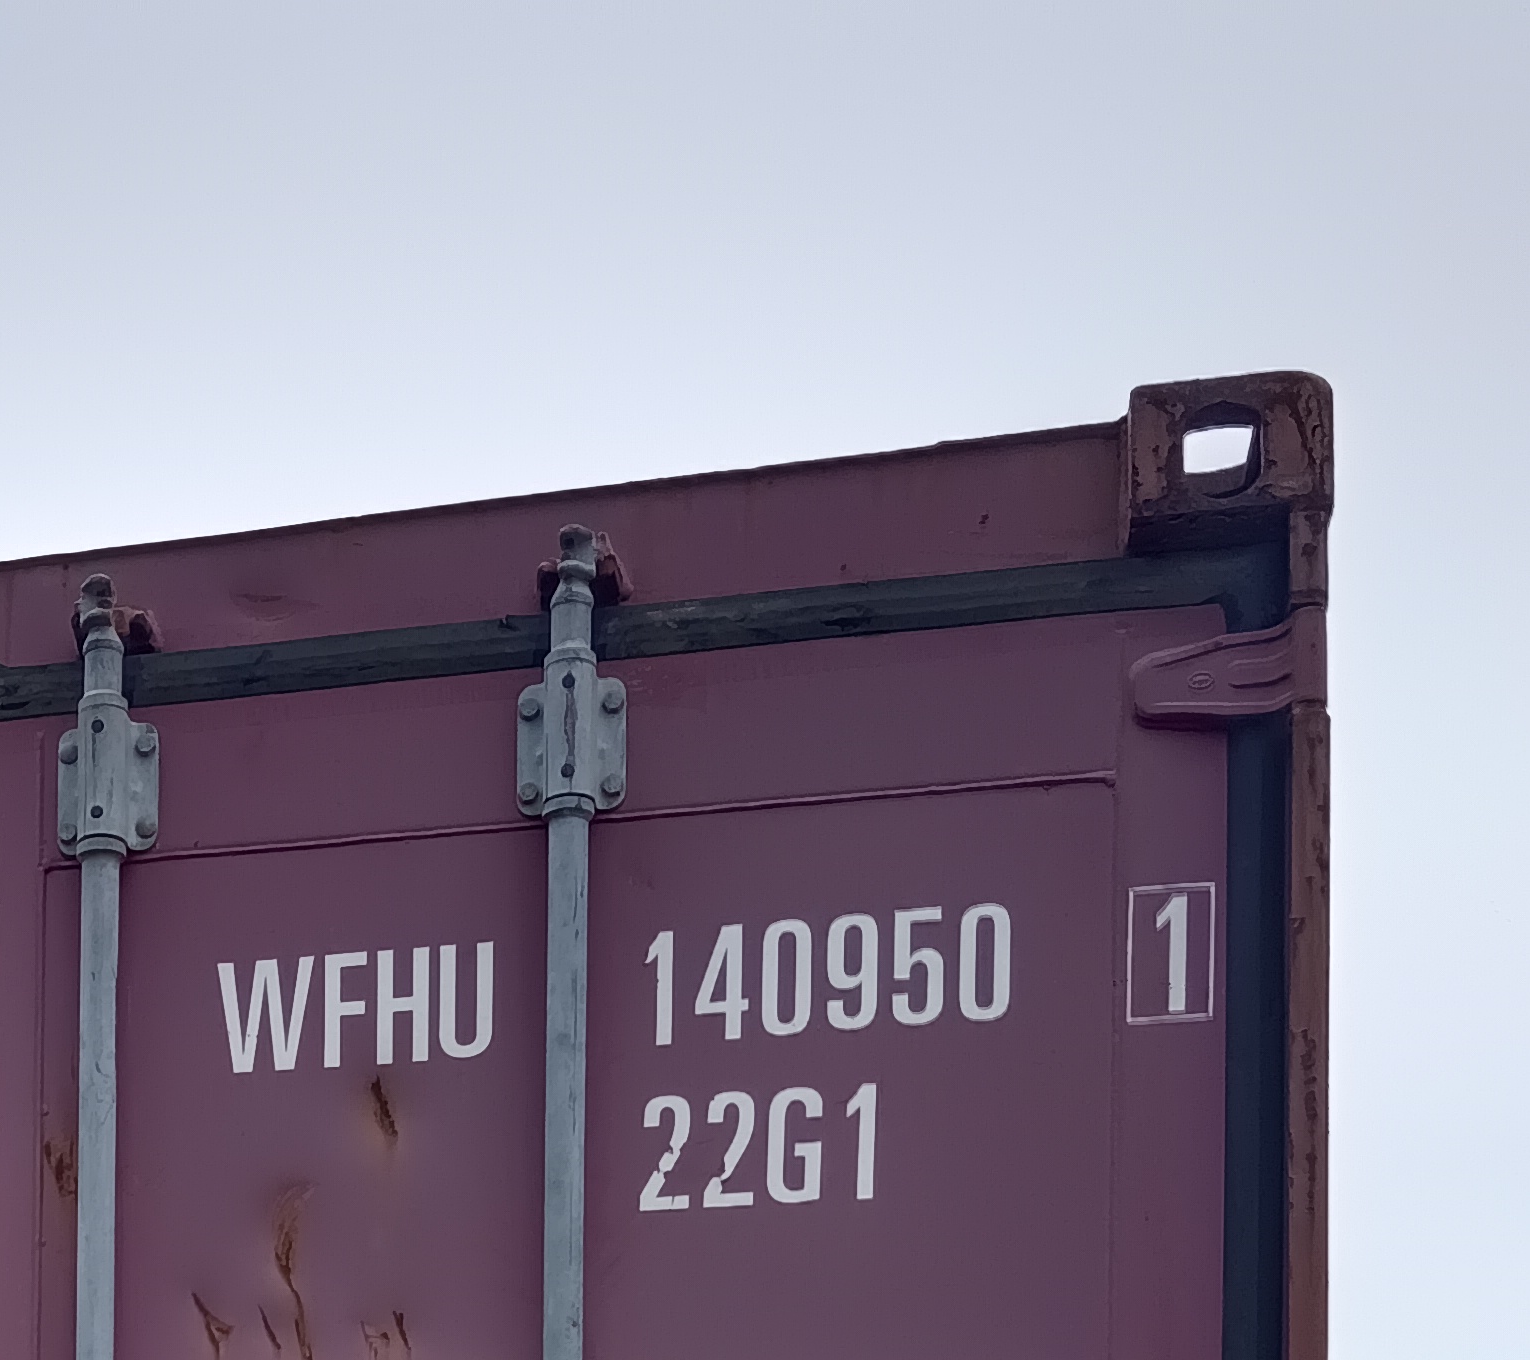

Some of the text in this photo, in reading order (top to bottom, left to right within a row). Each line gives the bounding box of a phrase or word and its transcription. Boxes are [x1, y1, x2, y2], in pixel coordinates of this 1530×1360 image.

[217, 893, 1188, 1074] WFHU 140950 1
[639, 1083, 877, 1212] 22G1
